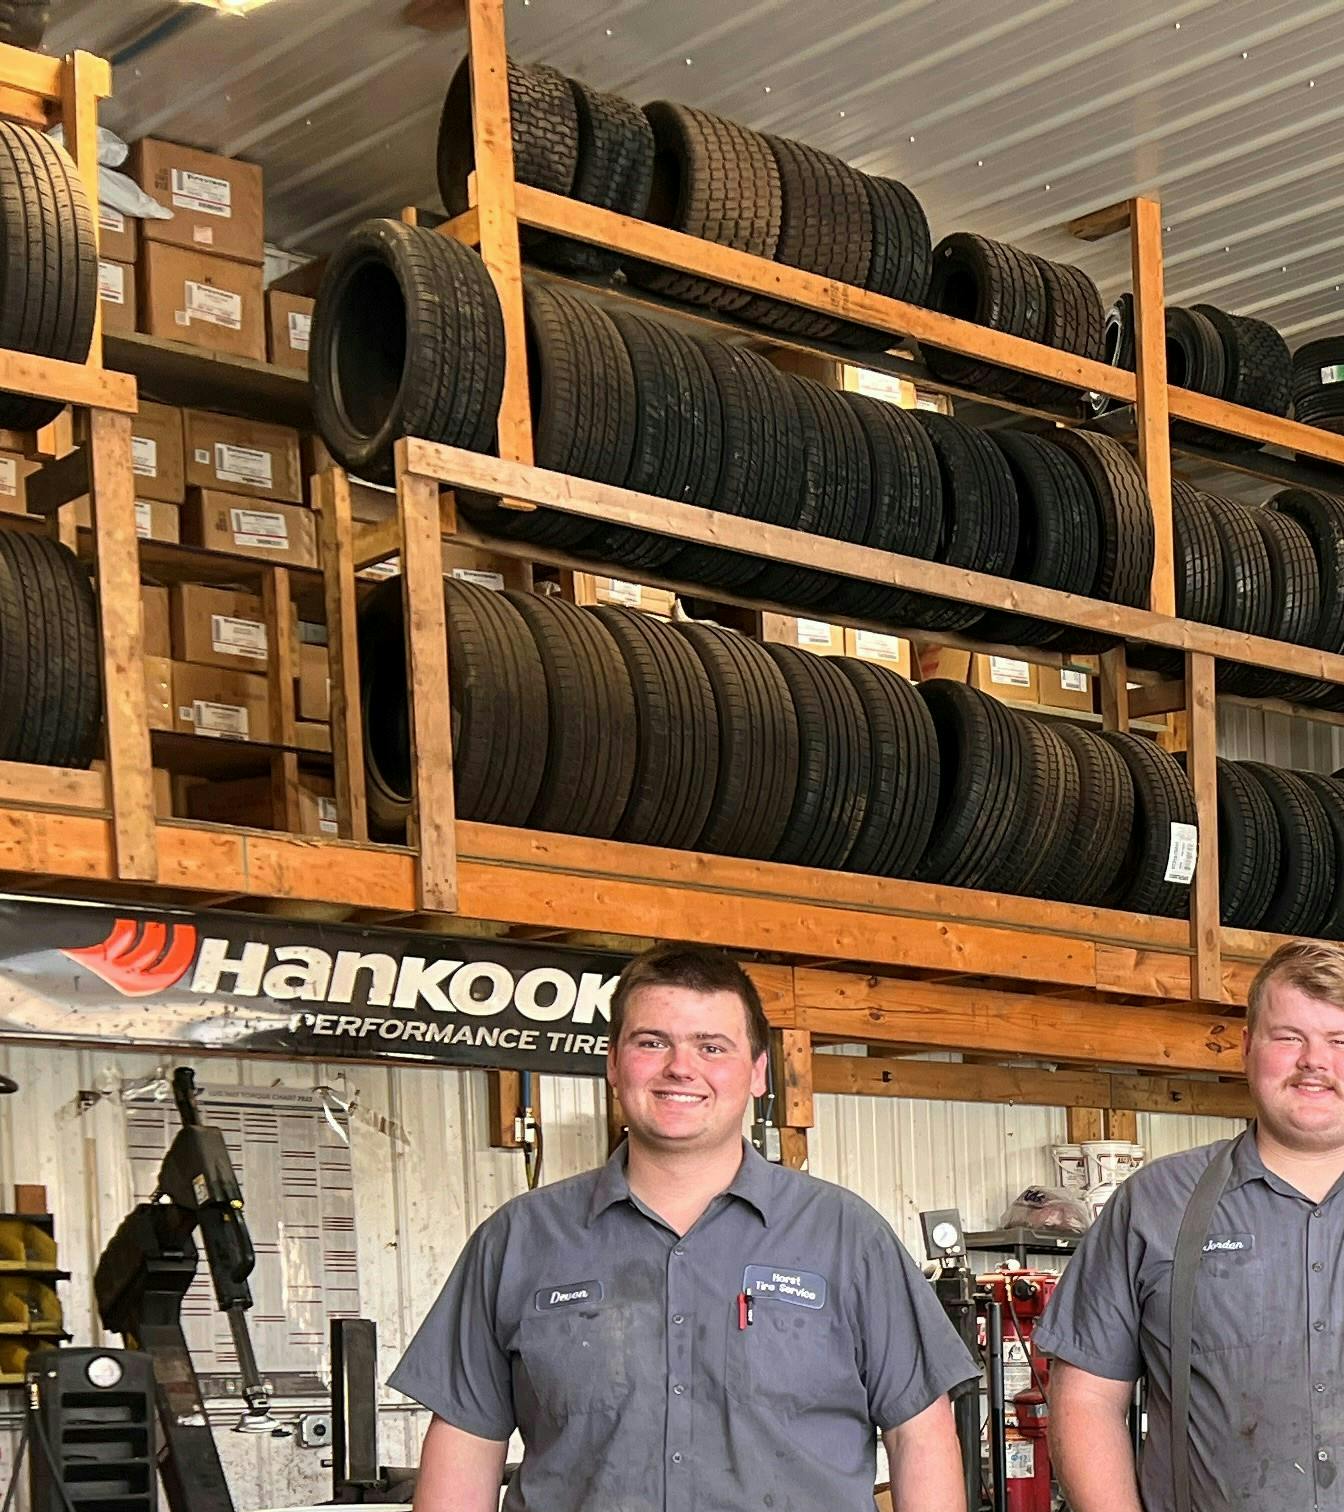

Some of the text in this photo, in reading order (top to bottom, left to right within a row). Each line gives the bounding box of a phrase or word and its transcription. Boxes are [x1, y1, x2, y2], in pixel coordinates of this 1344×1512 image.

[290, 1011, 540, 1050] PERFORMANCE
[1203, 1239, 1244, 1252] Jordan
[772, 1272, 801, 1287] Horst
[755, 1280, 816, 1301] Tire Service
